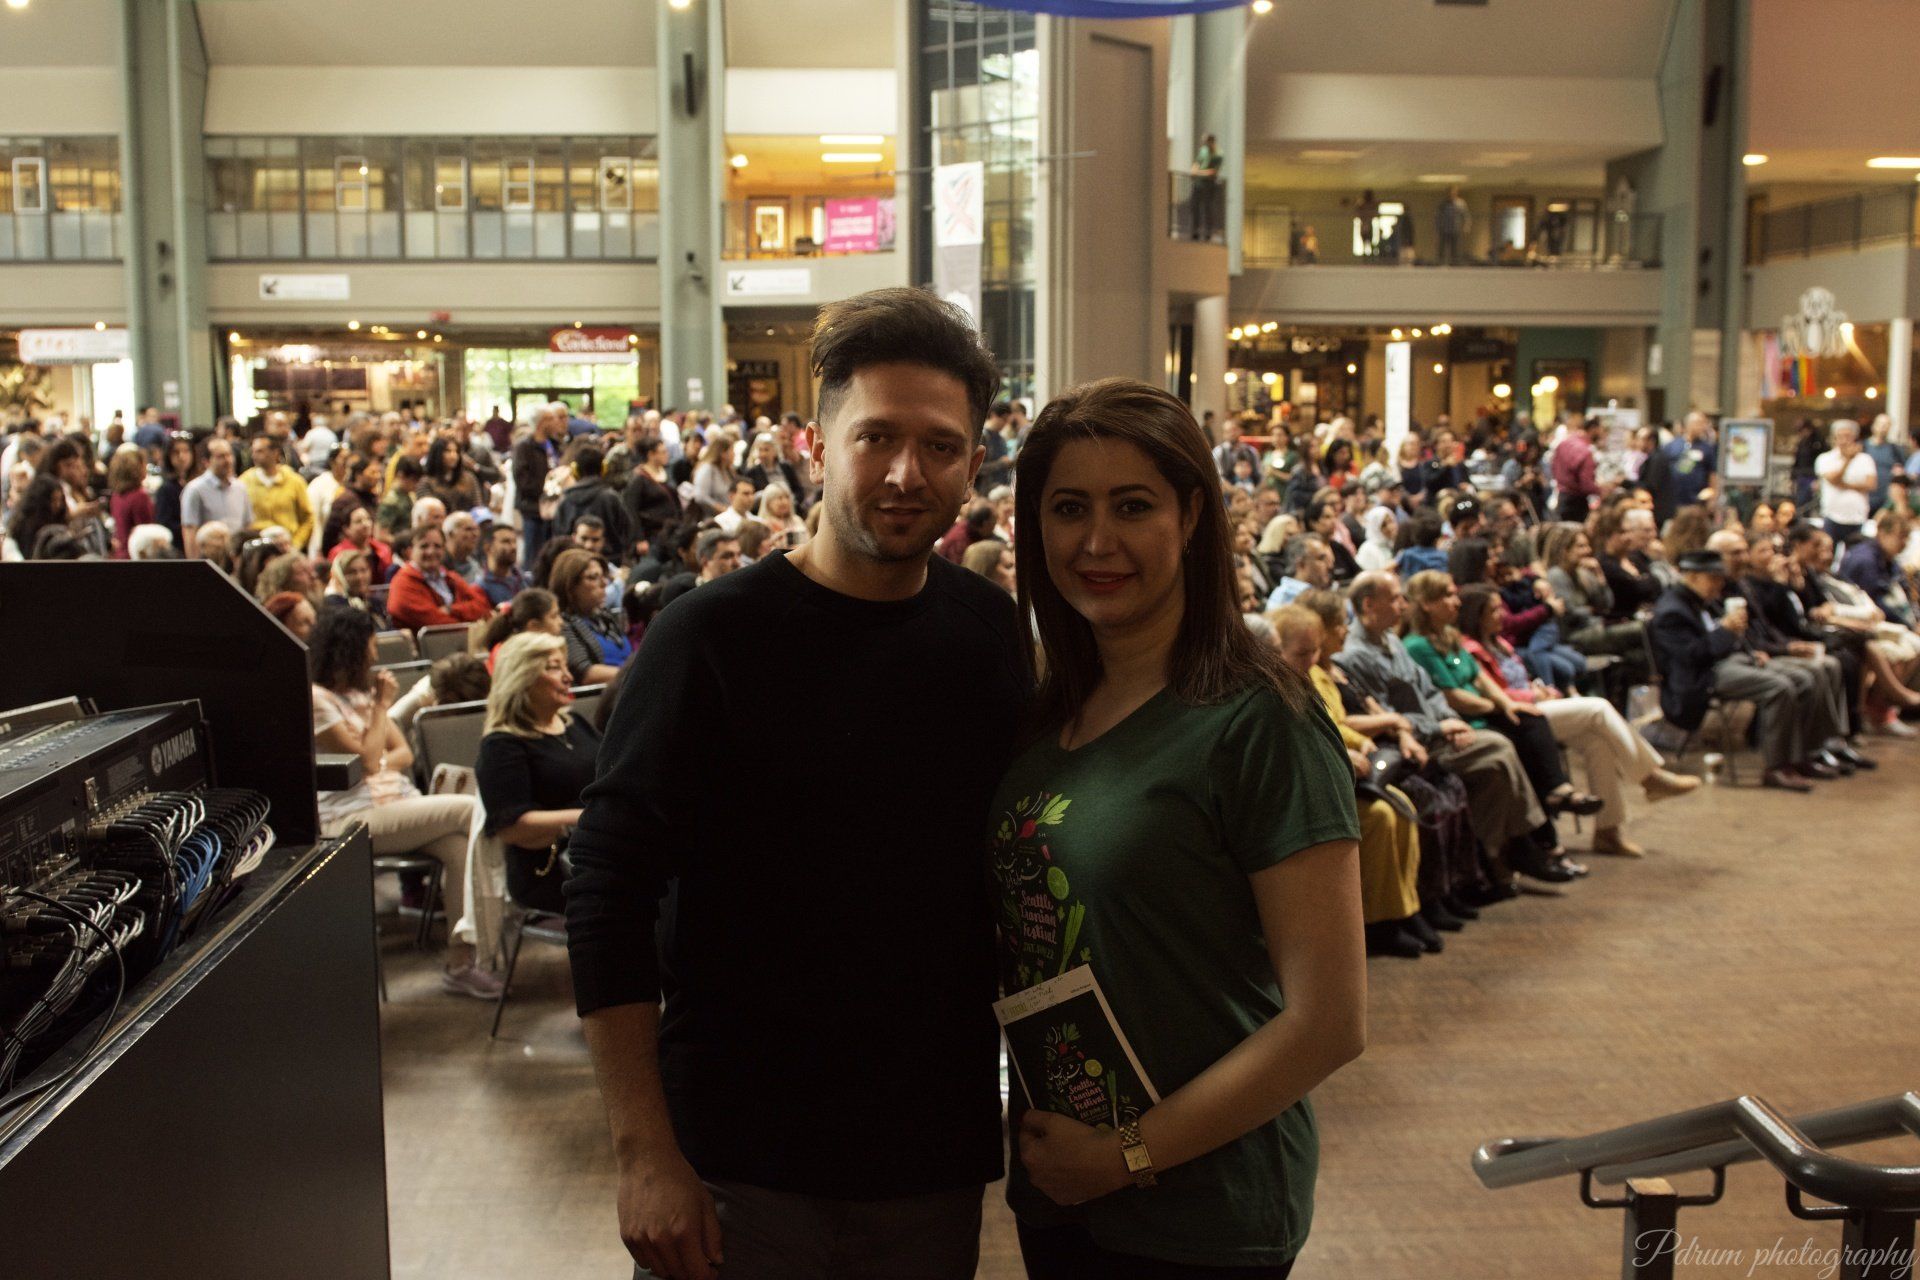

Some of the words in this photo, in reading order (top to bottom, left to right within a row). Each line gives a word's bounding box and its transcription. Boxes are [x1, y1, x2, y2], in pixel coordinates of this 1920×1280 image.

[161, 728, 196, 769] YAMAHA
[1021, 890, 1054, 911] Seattle
[1019, 903, 1057, 928] Iranian
[1023, 921, 1057, 945] Festival
[1067, 1086, 1102, 1104] Iranian
[1068, 1079, 1096, 1095] Seattle
[1074, 1093, 1106, 1112] Festival
